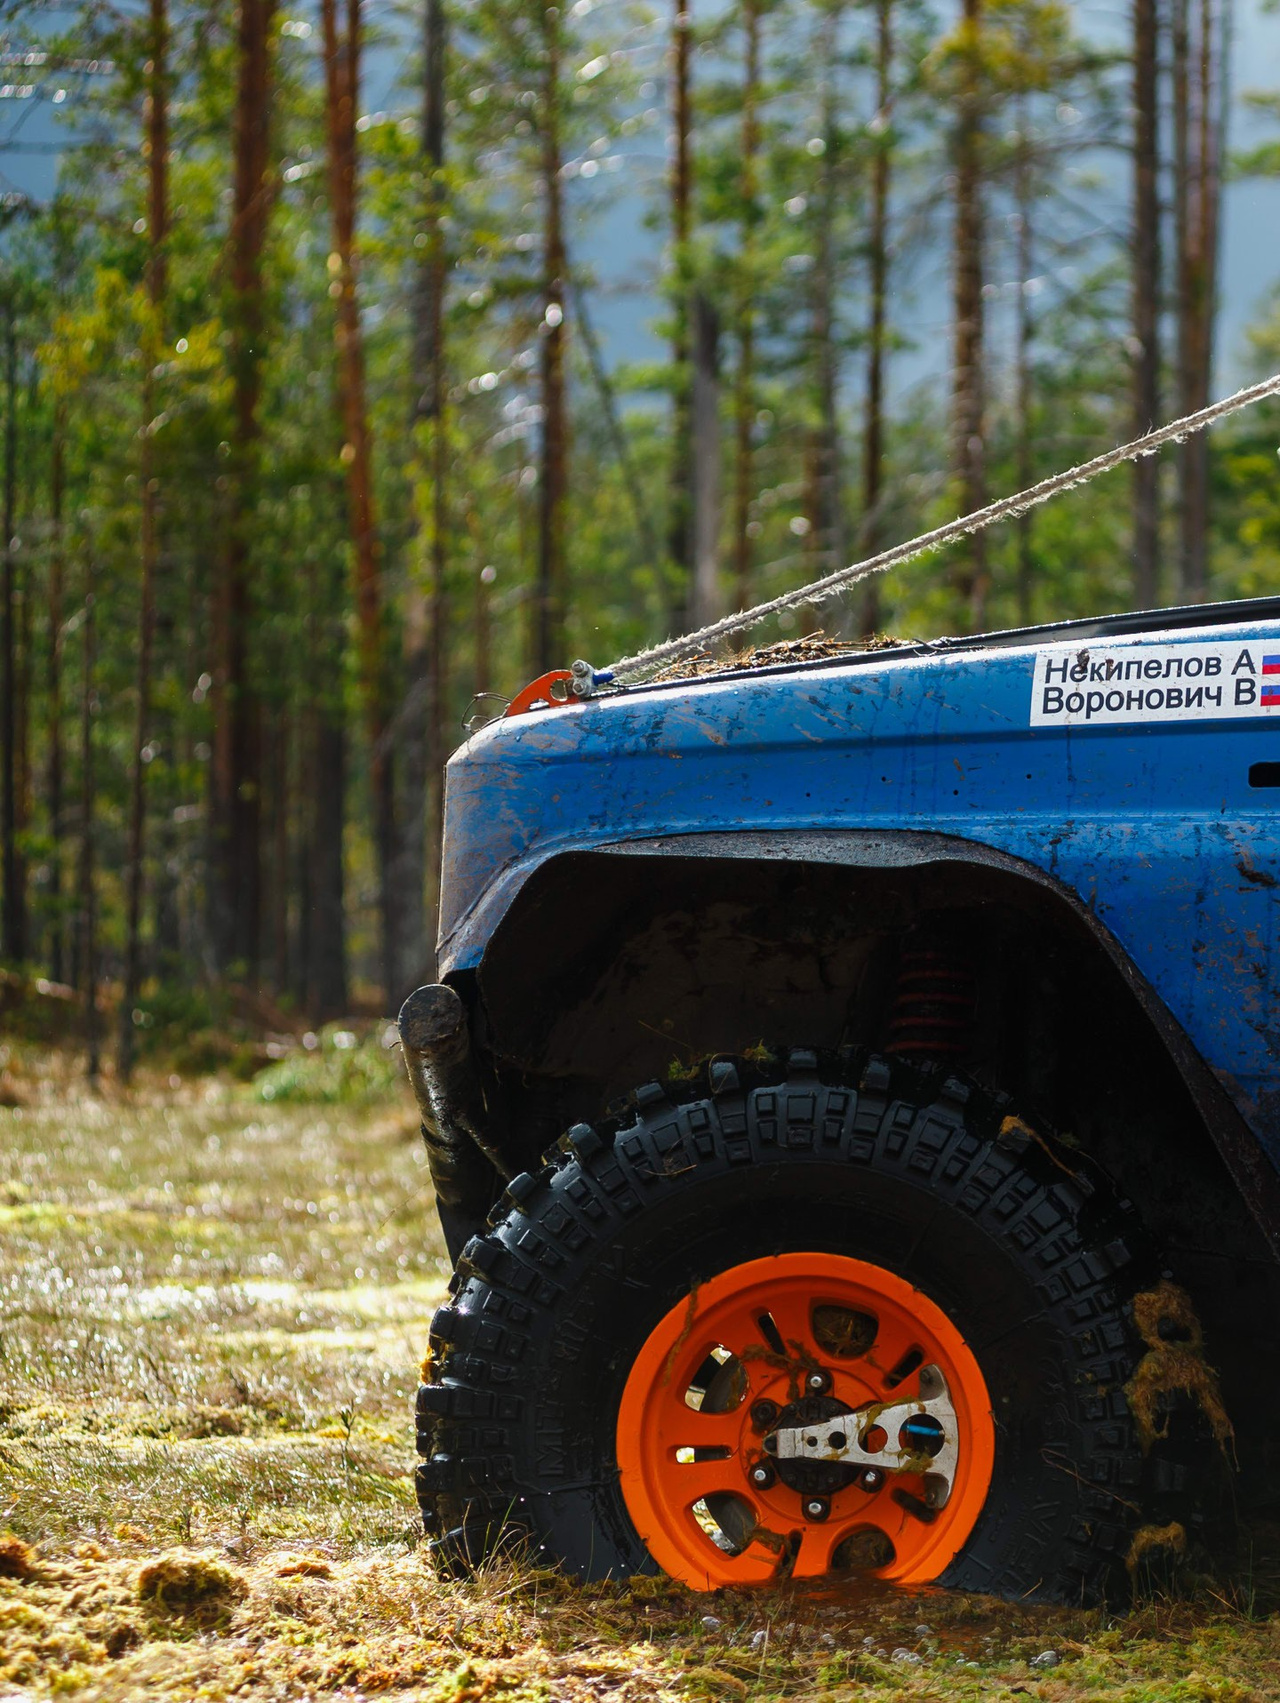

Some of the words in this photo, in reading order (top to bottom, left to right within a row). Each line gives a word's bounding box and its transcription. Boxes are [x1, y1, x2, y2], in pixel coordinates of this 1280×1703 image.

[1044, 656, 1222, 684] Некипелов
[1042, 686, 1222, 719] Воронович
[1234, 678, 1257, 706] В
